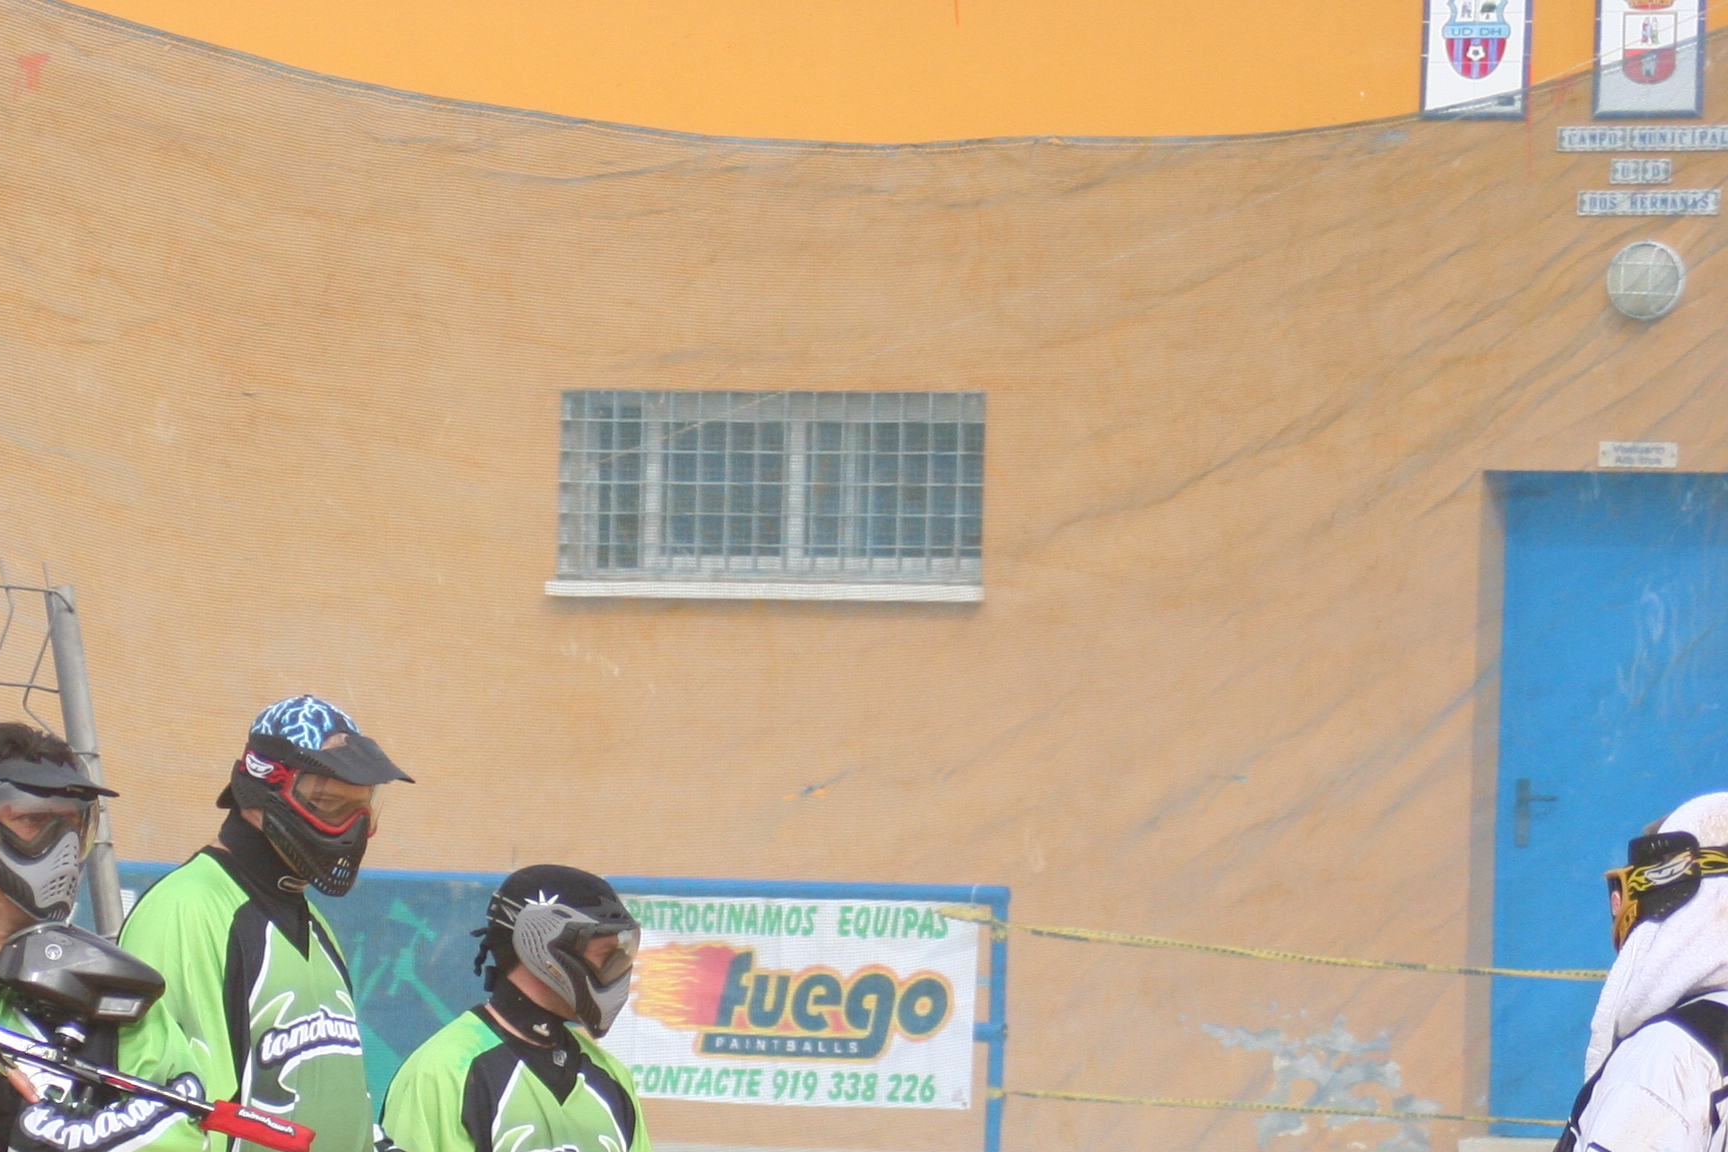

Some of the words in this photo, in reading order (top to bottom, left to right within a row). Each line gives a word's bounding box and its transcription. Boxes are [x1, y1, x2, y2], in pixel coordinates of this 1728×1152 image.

[1452, 28, 1472, 36] UD
[1479, 28, 1502, 36] DH
[1568, 131, 1618, 147] CAMPO
[715, 1037, 860, 1054] PAINTBALLS
[630, 1065, 763, 1097] CONTACTE
[771, 1069, 819, 1099] 919
[828, 1072, 879, 1102] 338
[887, 1074, 936, 1103] 226
